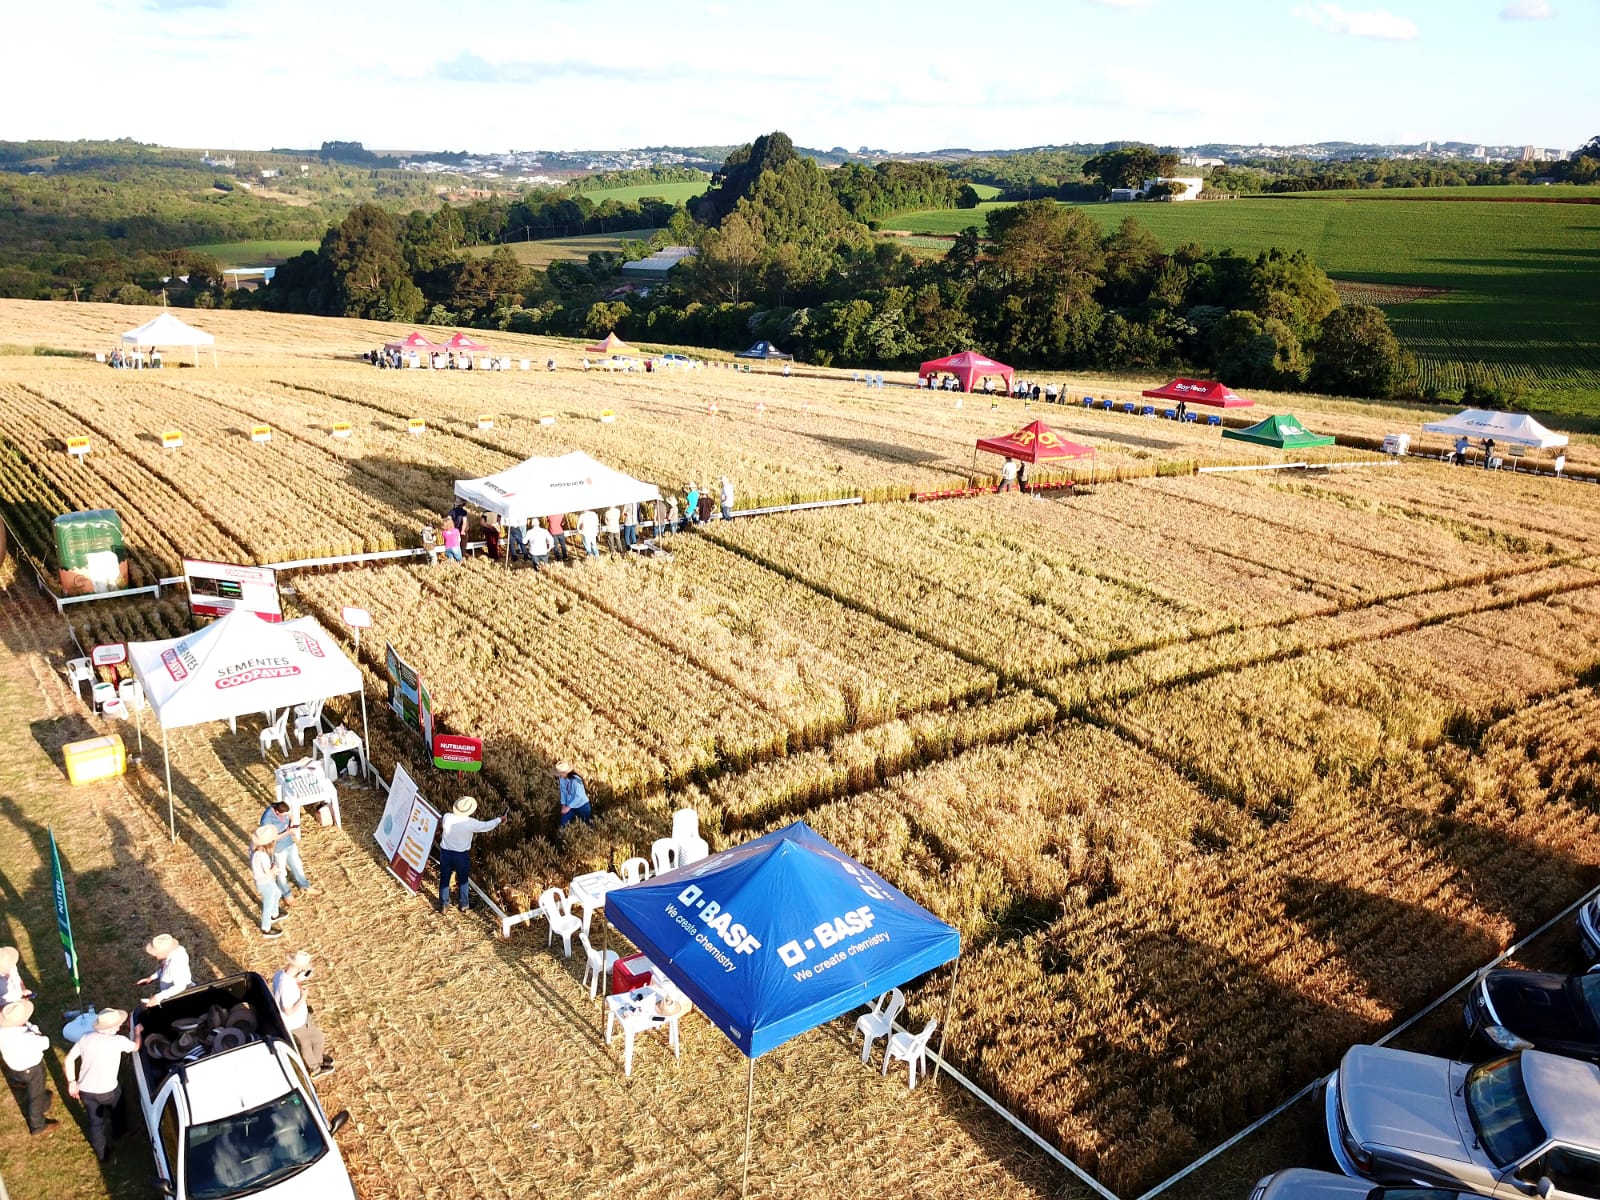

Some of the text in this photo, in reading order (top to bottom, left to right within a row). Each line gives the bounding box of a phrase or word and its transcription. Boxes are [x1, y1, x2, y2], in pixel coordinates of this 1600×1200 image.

[217, 657, 289, 677] SEMENTES
[217, 666, 301, 689] COOPAVEL
[665, 903, 737, 973] We create chemistry
[698, 900, 762, 955] BASF
[813, 905, 875, 950] BASF
[793, 931, 890, 982] We create chemistry
